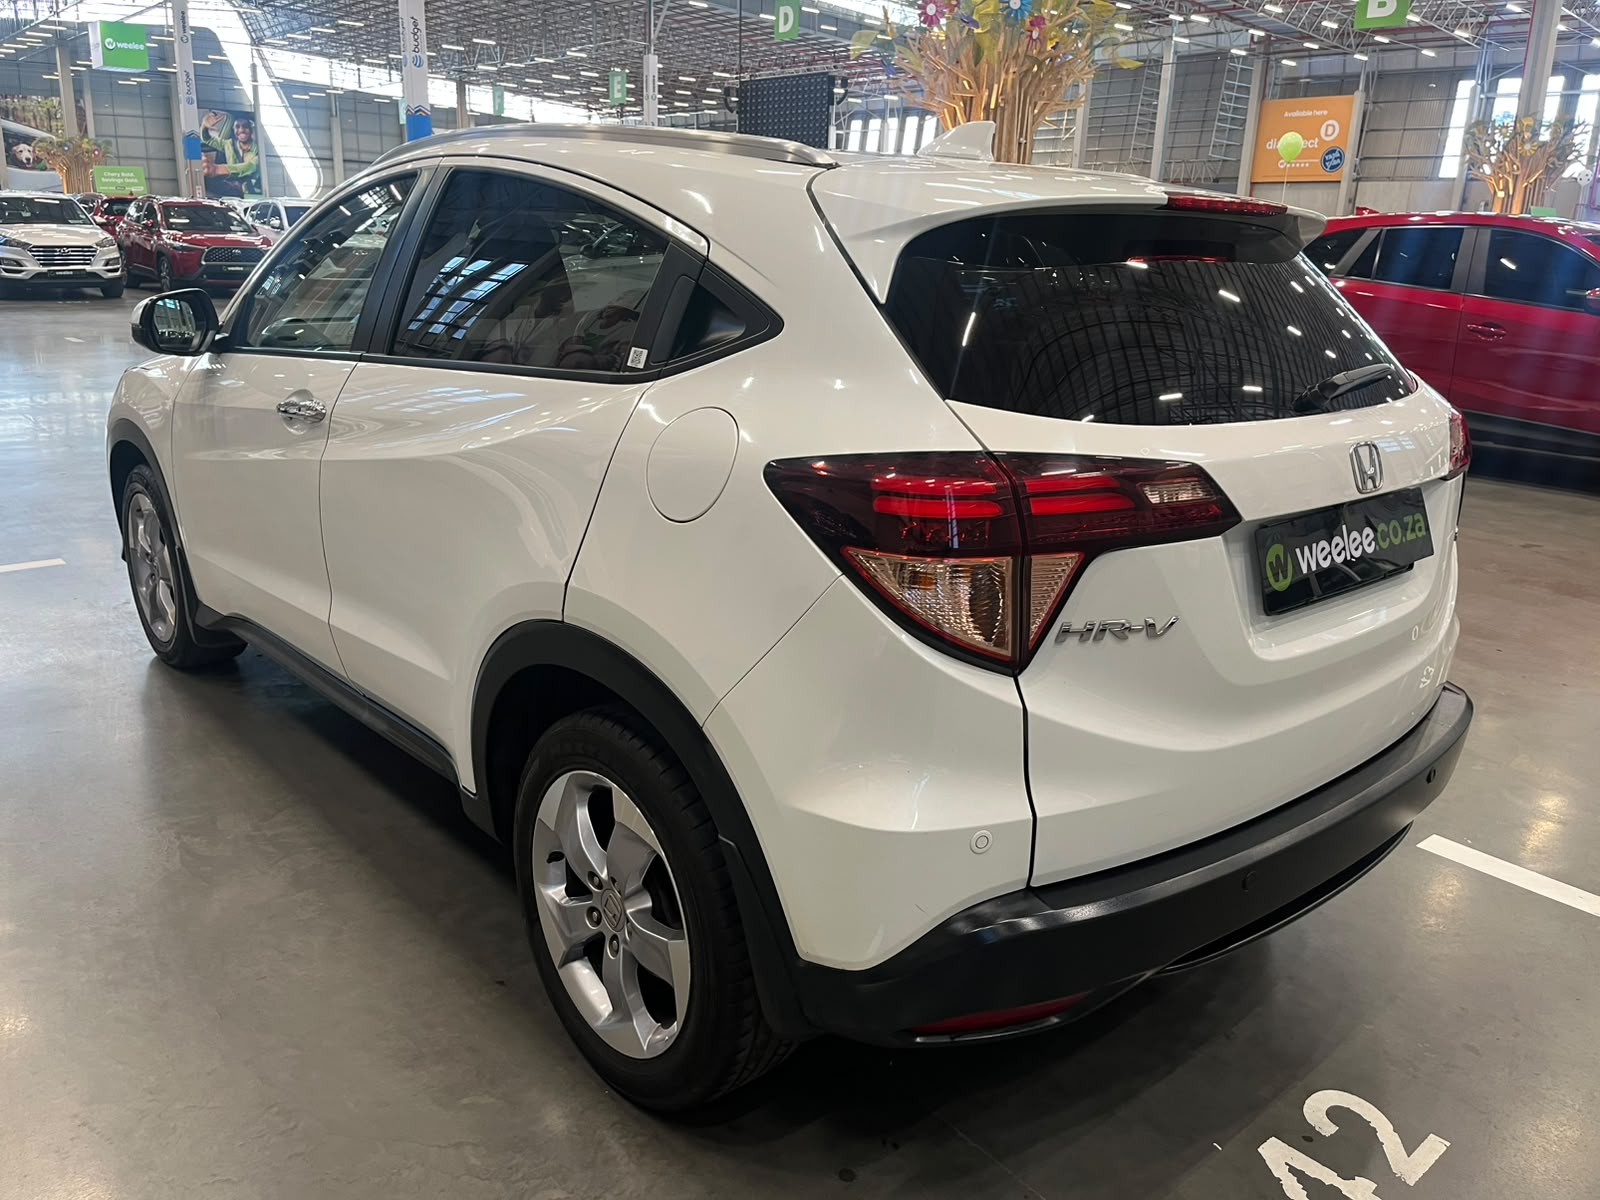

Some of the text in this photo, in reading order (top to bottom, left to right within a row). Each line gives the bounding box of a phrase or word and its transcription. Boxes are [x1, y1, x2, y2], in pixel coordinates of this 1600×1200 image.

[779, 5, 794, 32] D
[116, 41, 145, 50] weelee
[410, 16, 422, 53] budget
[614, 75, 622, 99] E
[1295, 512, 1427, 575] weelee.co.za
[1055, 616, 1180, 643] HR-V
[1257, 1089, 1451, 1200] 42
